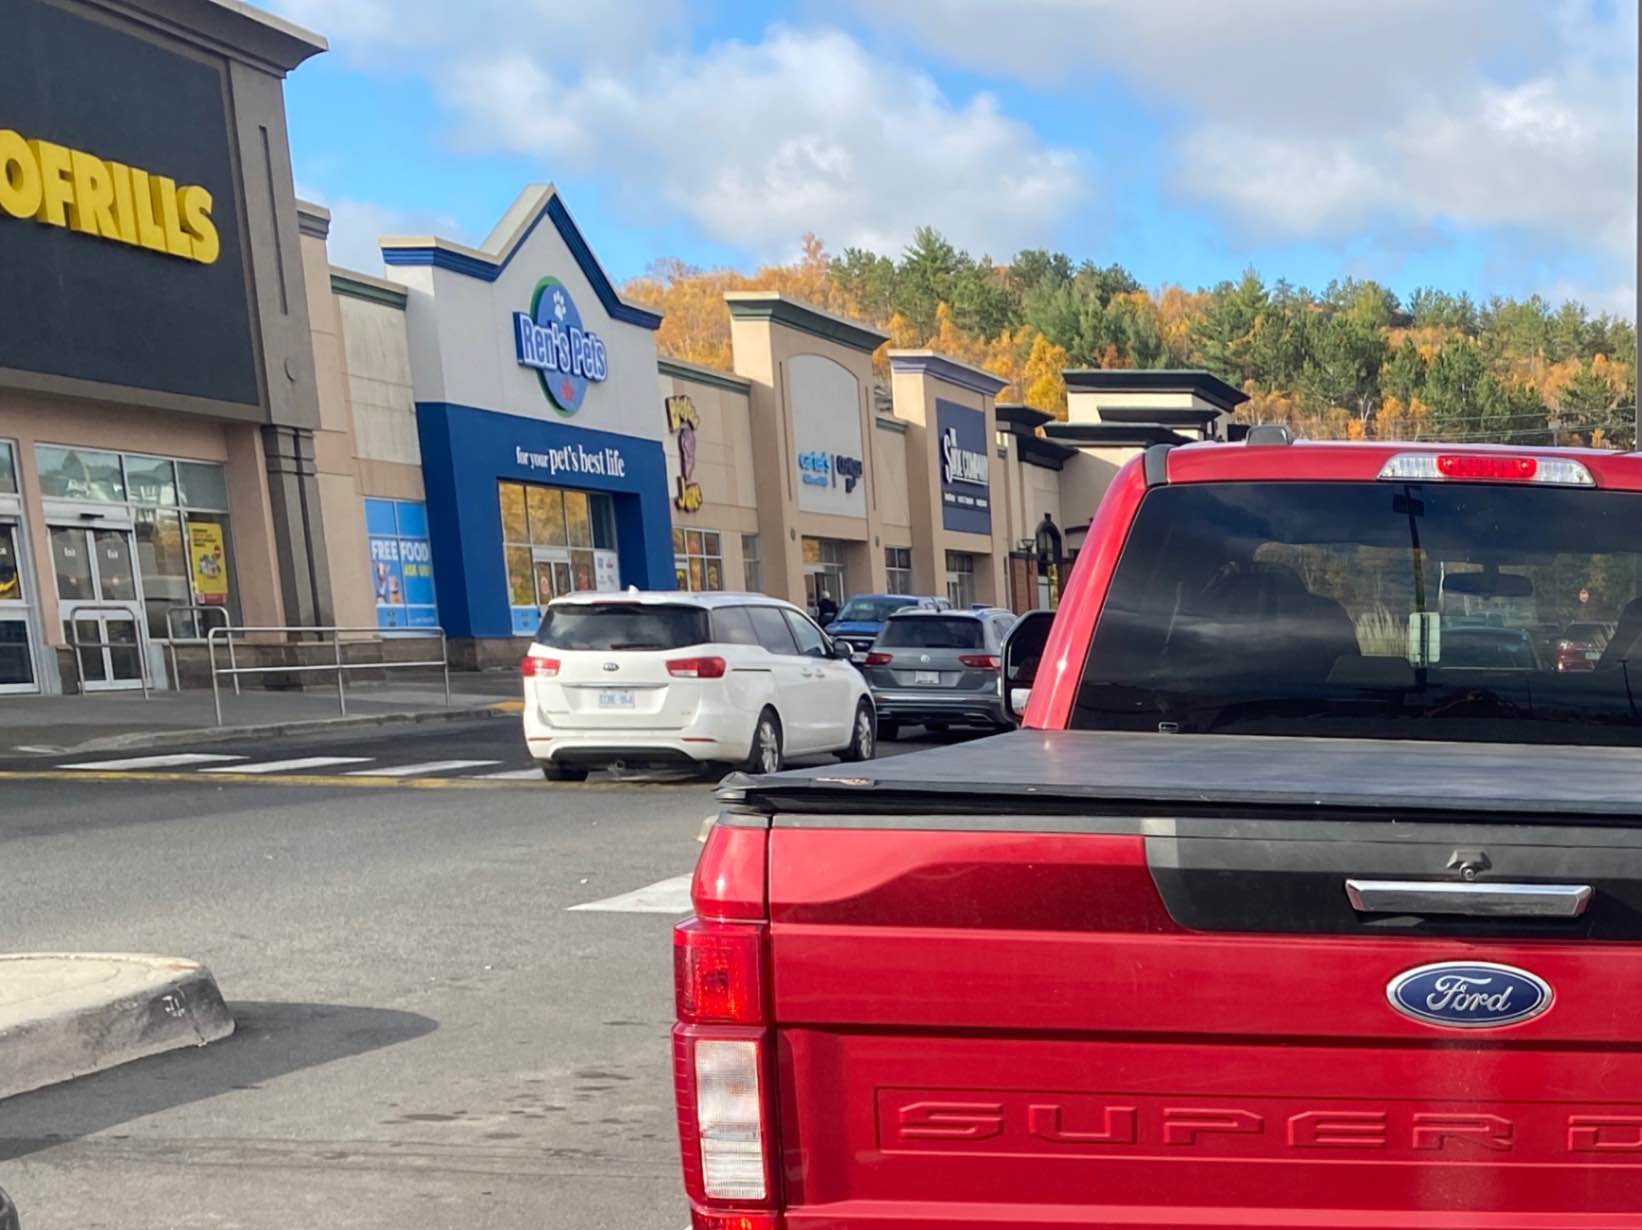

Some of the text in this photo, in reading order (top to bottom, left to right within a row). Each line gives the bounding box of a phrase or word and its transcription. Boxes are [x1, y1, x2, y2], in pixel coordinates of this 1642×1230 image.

[517, 314, 609, 382] Ren's Pets
[515, 444, 626, 478] for your pet's best life
[371, 539, 429, 562] FREE FOOD
[1426, 974, 1514, 1011] Ford
[898, 1100, 1514, 1152] SUPER
